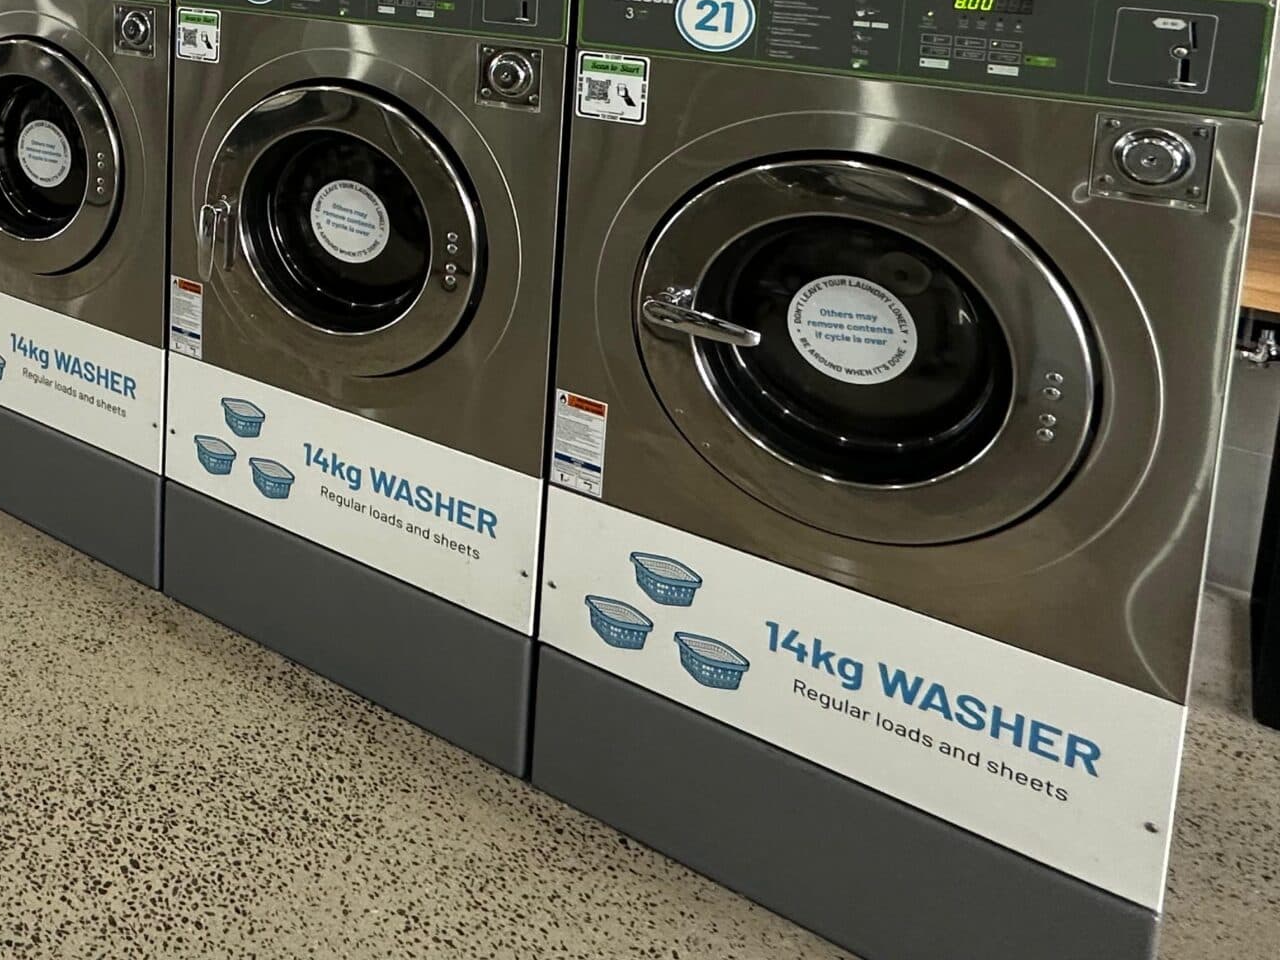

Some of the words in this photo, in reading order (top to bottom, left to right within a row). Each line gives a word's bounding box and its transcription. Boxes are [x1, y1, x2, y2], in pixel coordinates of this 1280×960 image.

[625, 8, 634, 19] 3
[694, 0, 735, 33] 21
[794, 303, 804, 324] DON'T
[800, 283, 823, 302] LEAVE
[823, 279, 847, 288] YOUR
[848, 280, 891, 303] LAUNDRY
[888, 303, 909, 335] LONELY
[807, 320, 845, 330] remove
[847, 323, 894, 335] contents
[820, 308, 854, 320] Others
[856, 313, 878, 323] may
[800, 337, 811, 348] BE
[808, 348, 843, 373] AROUND
[844, 367, 872, 377] WHEN
[887, 347, 907, 368] DONE
[824, 332, 851, 343] cycle
[864, 337, 888, 346] over
[10, 333, 49, 370] 14kg
[54, 348, 136, 399] WASHER
[22, 367, 54, 388] Regular
[54, 380, 78, 399] loads
[78, 390, 95, 406] and
[96, 396, 126, 418] sheets
[303, 442, 362, 491] 14kg
[370, 466, 498, 540] WASHER
[320, 485, 367, 514] Regular
[369, 505, 403, 529] loads
[405, 521, 430, 540] and
[433, 533, 481, 560] sheets
[765, 621, 863, 691] 14kg
[878, 661, 1102, 778] WASHER
[793, 679, 871, 722] Regular
[876, 712, 934, 748] loads
[938, 740, 981, 768] and
[986, 759, 1070, 802] sheets
